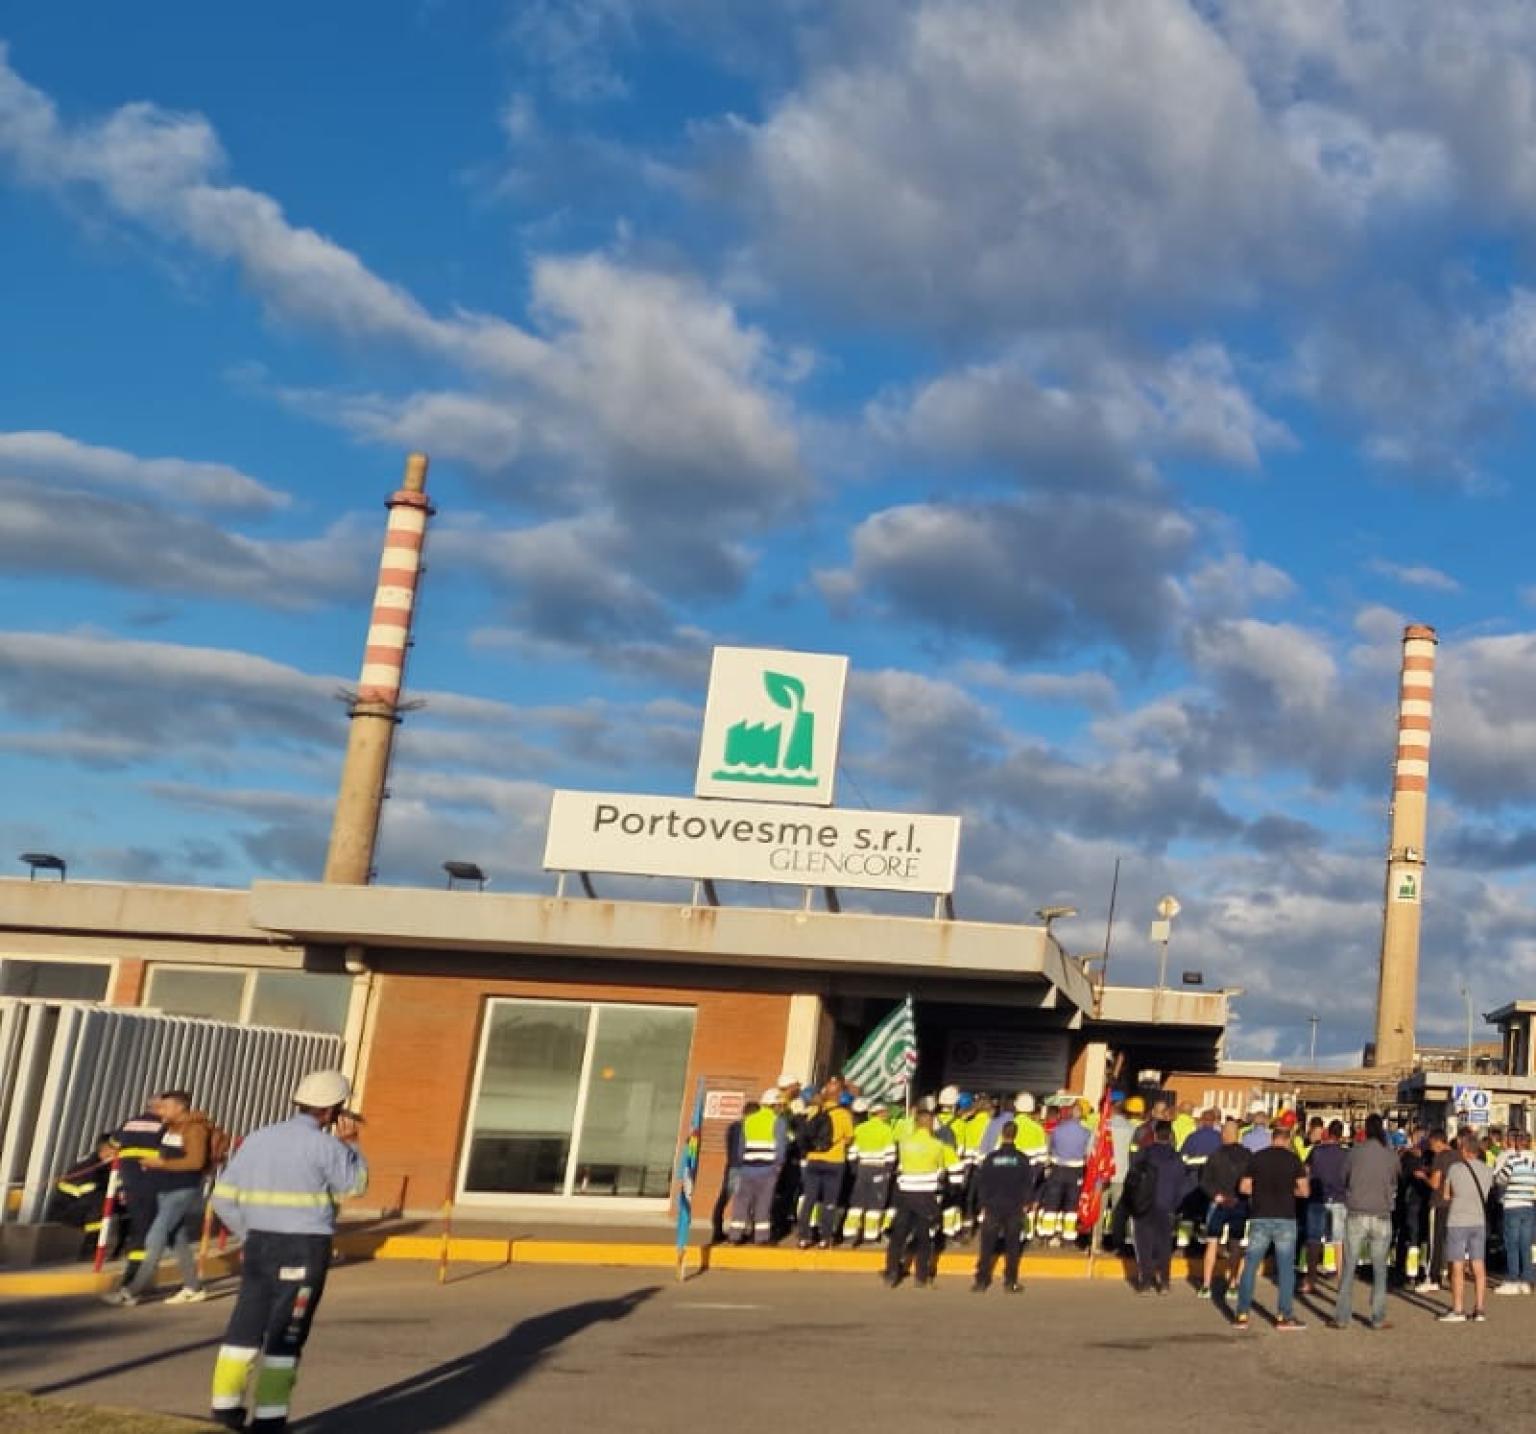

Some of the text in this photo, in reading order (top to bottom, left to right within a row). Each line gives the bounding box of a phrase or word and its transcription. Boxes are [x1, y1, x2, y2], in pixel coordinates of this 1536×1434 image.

[593, 804, 922, 853] Portovesme s.r.l.
[769, 848, 920, 878] GLENCORE
